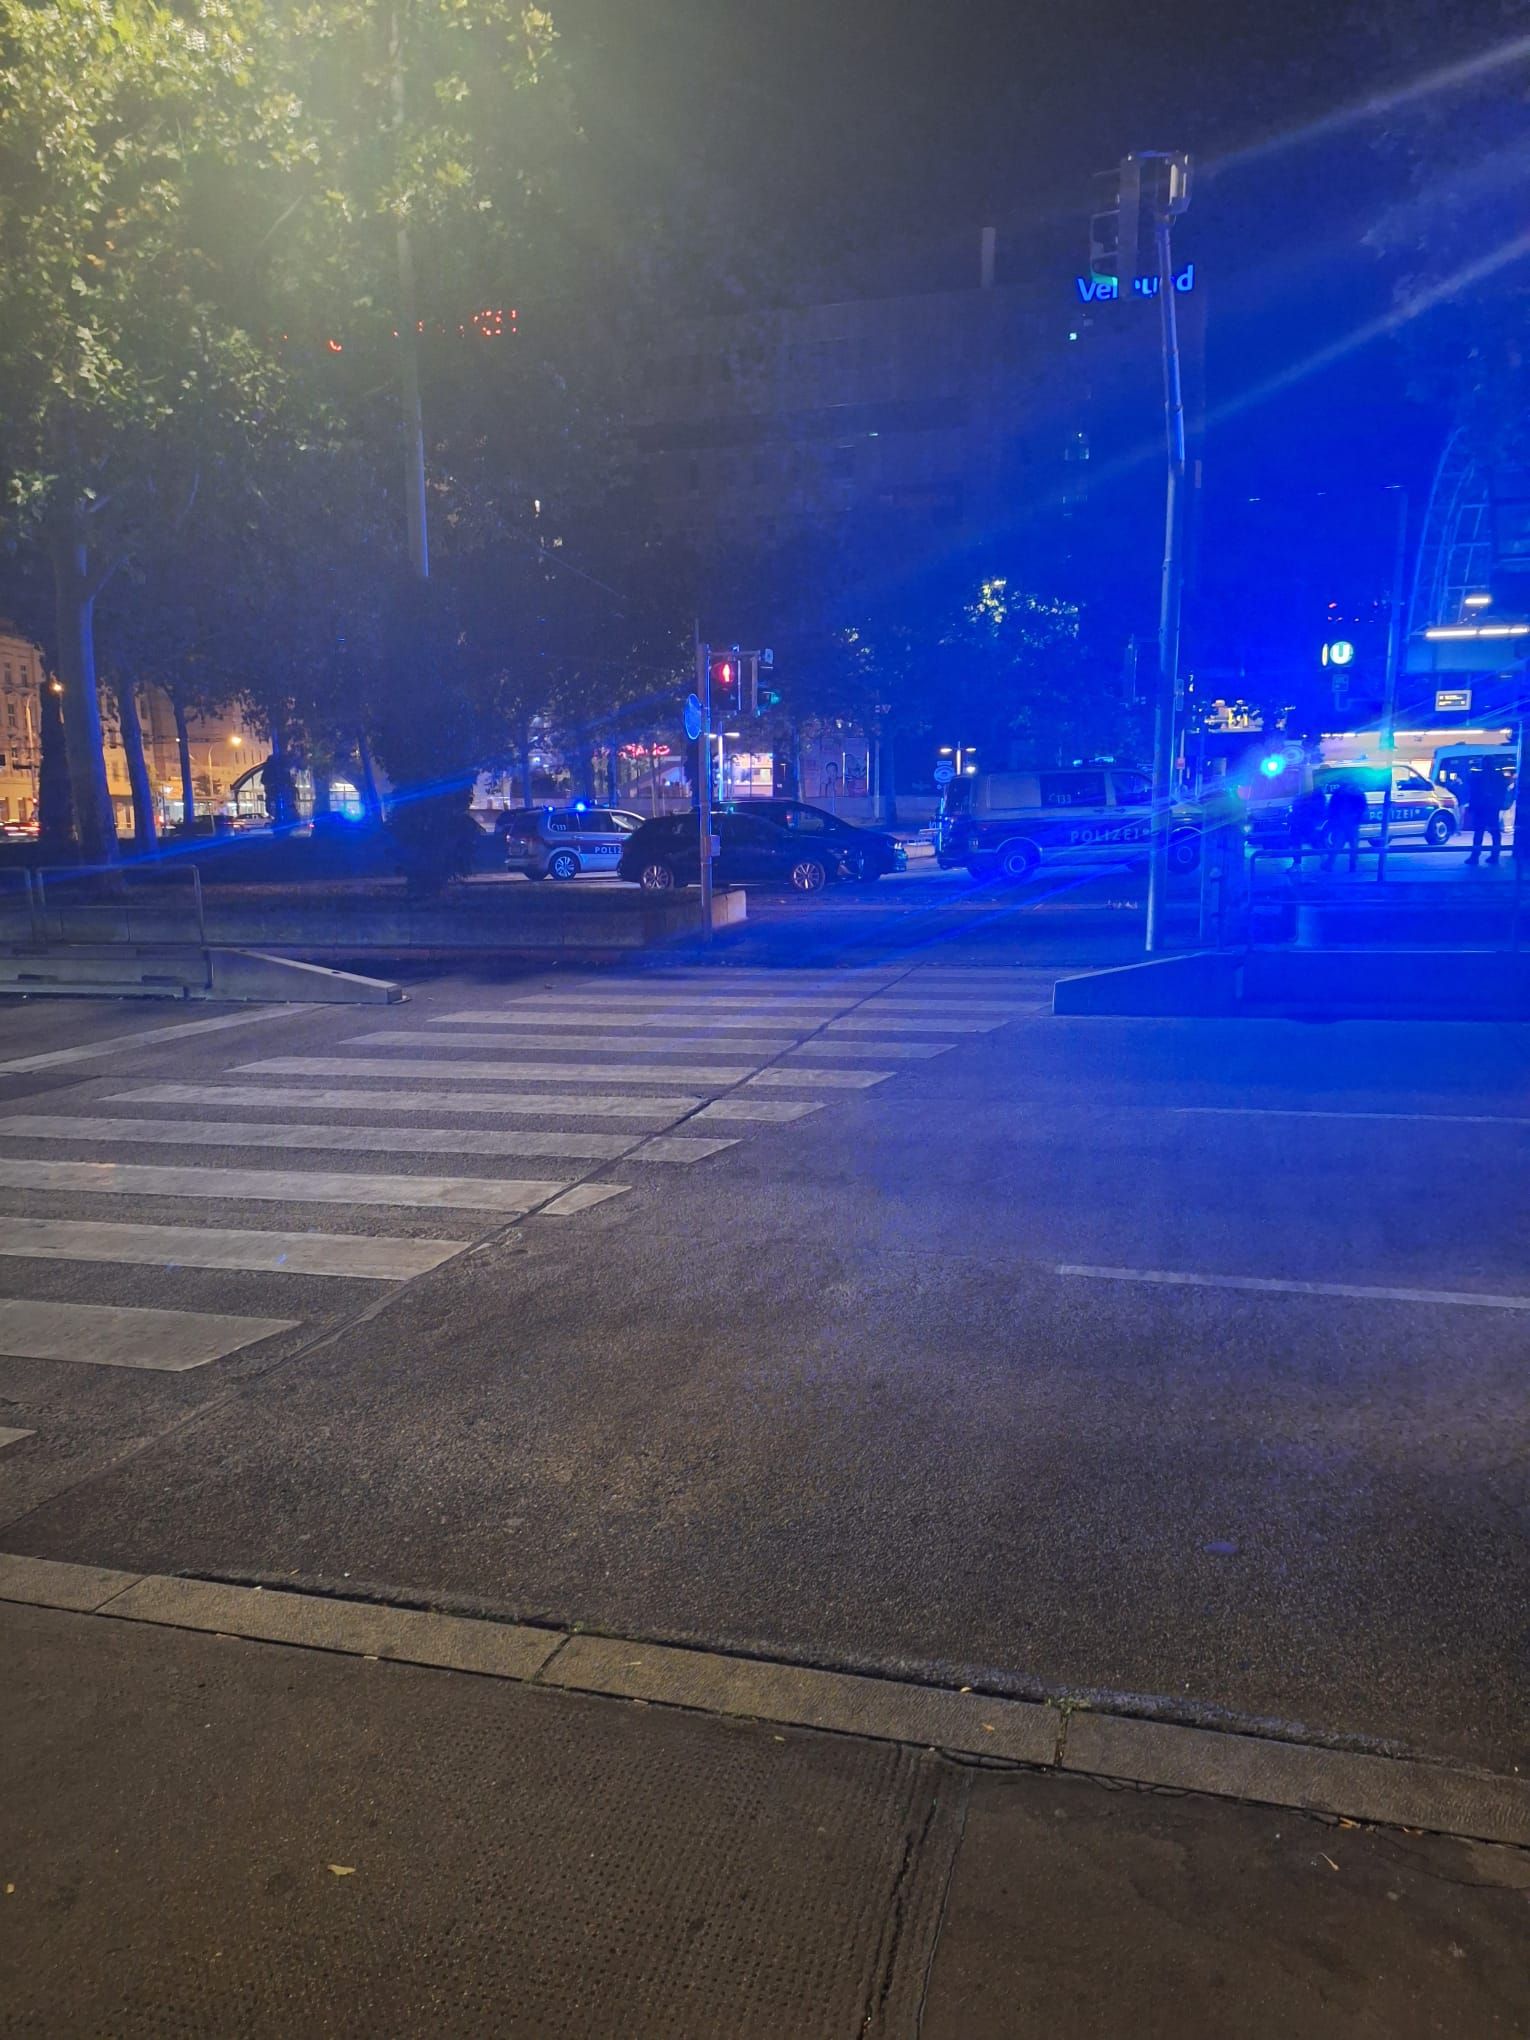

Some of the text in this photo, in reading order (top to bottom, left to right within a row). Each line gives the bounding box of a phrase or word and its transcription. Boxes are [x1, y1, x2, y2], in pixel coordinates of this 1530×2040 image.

[1332, 641, 1350, 662] U
[1369, 808, 1414, 820] POIZEI
[1071, 828, 1139, 842] POLIZEI
[594, 846, 622, 854] POLIZ
